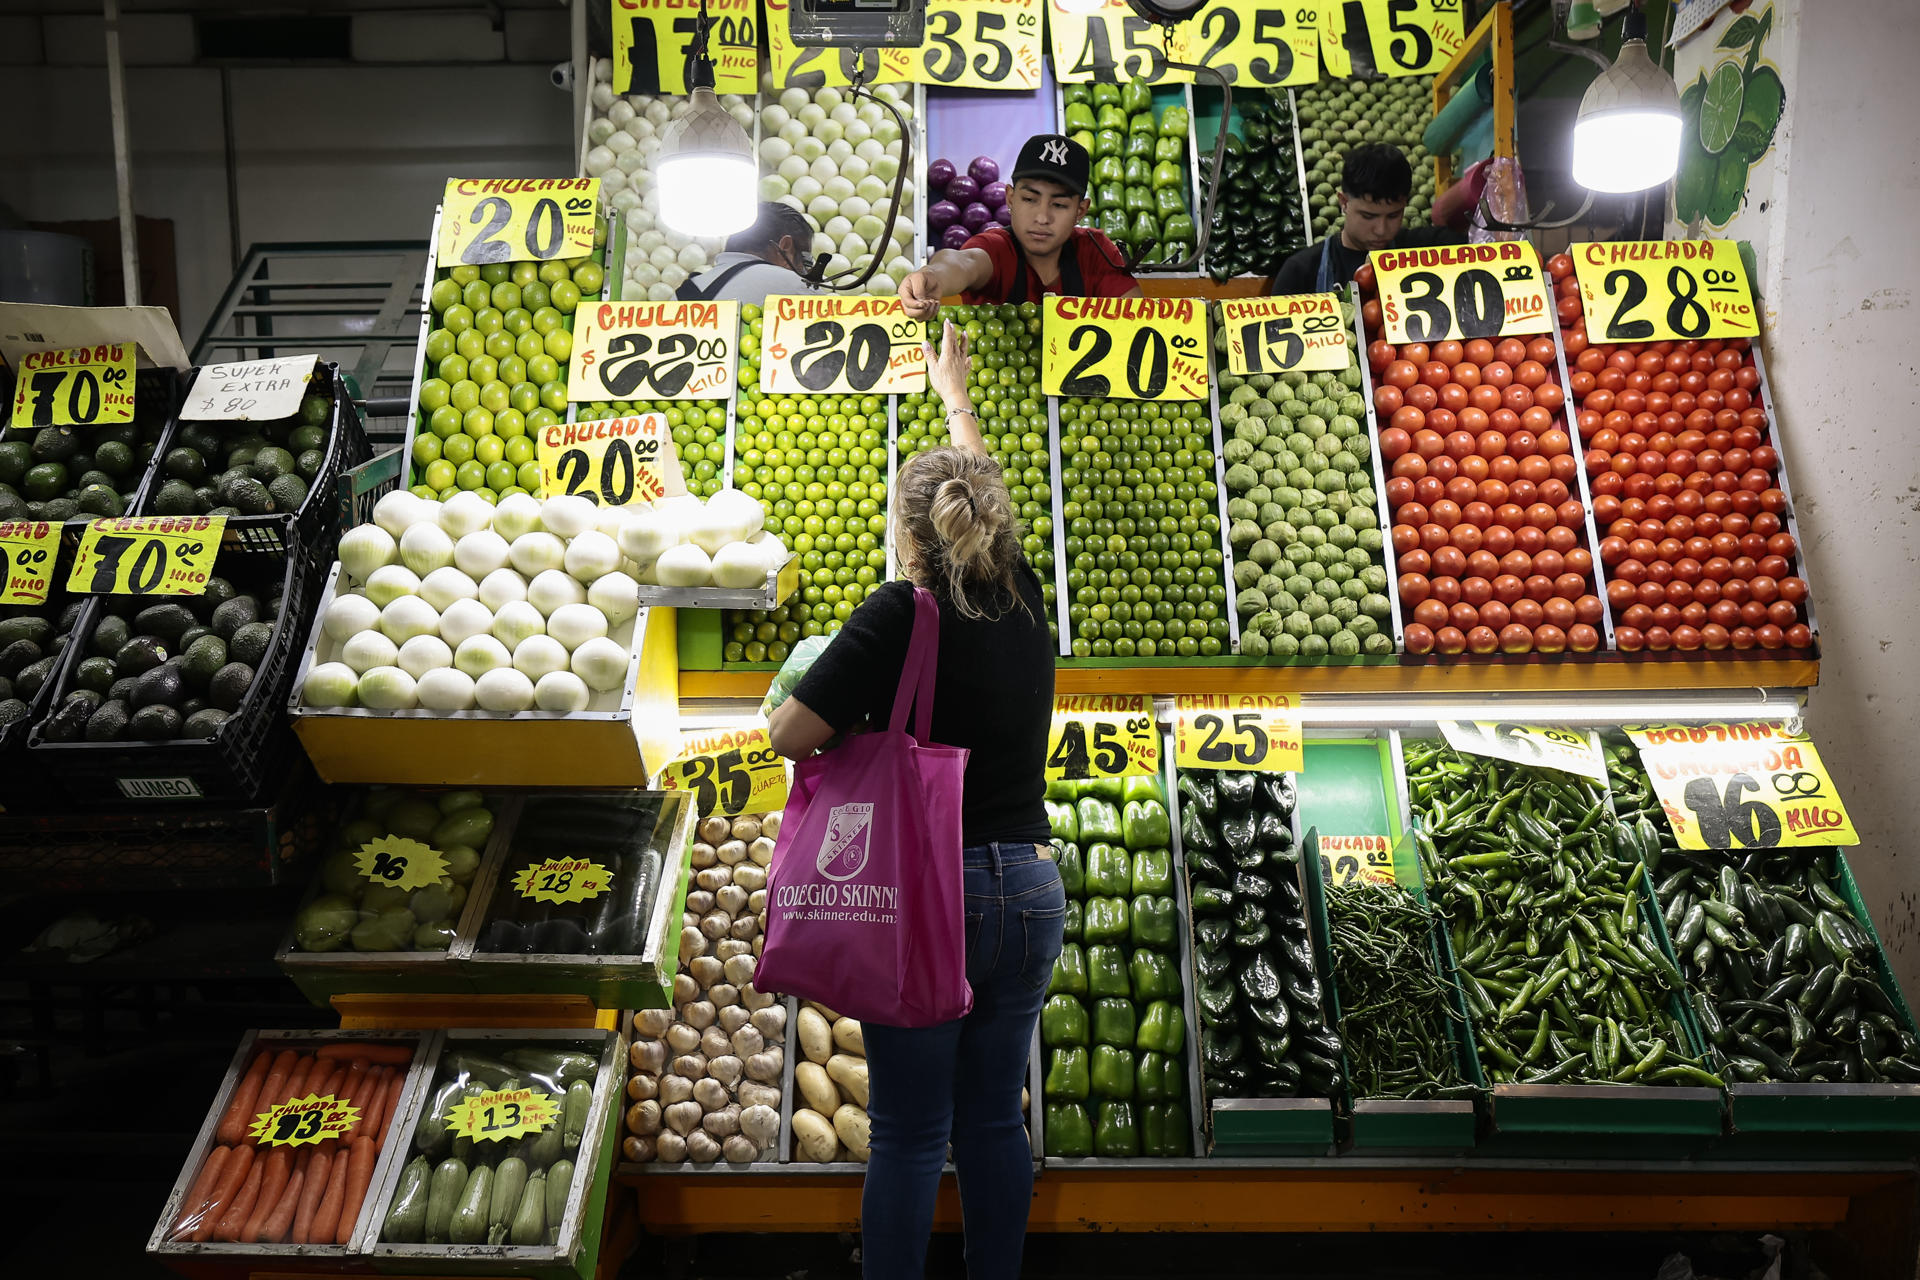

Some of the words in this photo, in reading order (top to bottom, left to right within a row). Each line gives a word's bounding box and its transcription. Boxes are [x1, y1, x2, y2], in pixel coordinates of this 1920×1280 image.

[923, 11, 1012, 82] 35
[722, 54, 757, 69] KILO
[1016, 44, 1040, 77] KILO
[1039, 139, 1069, 166] NY
[457, 178, 592, 195] CHULADA
[461, 196, 564, 264] 20
[1378, 243, 1522, 271] CHULADA
[1586, 240, 1714, 266] CHULADA
[778, 298, 907, 321] CHULADA
[1056, 297, 1194, 324] CHULADA
[1226, 299, 1334, 319] CHULADA
[1400, 269, 1505, 342] 30
[1505, 295, 1543, 316] KILO
[1604, 266, 1710, 339] 28
[1710, 299, 1751, 314] KILO
[597, 303, 718, 331] CHULADA
[1241, 317, 1304, 372] 15
[1306, 333, 1345, 349] KILO
[210, 364, 281, 379] SUPER
[889, 347, 924, 370] KILO
[1060, 325, 1168, 398] 20
[1172, 357, 1209, 385] KILO
[221, 379, 290, 392] EXTRA
[688, 367, 727, 395] KILO
[545, 416, 657, 447] CHULADA
[636, 465, 665, 497] KILO
[678, 730, 764, 757] HULADA
[1047, 721, 1128, 780] 45
[1127, 740, 1157, 758] KILO
[1194, 714, 1268, 765] 25
[1271, 738, 1299, 751] KILO
[129, 780, 192, 796] JUMBO
[1684, 773, 1782, 849] 16
[1786, 806, 1843, 832] KILO
[371, 852, 408, 880] 16
[539, 861, 590, 872] CHULADA
[538, 872, 573, 893] 18
[777, 884, 838, 908] COLEGIO
[273, 1101, 339, 1118] CHULADA
[481, 1103, 520, 1132] 13
